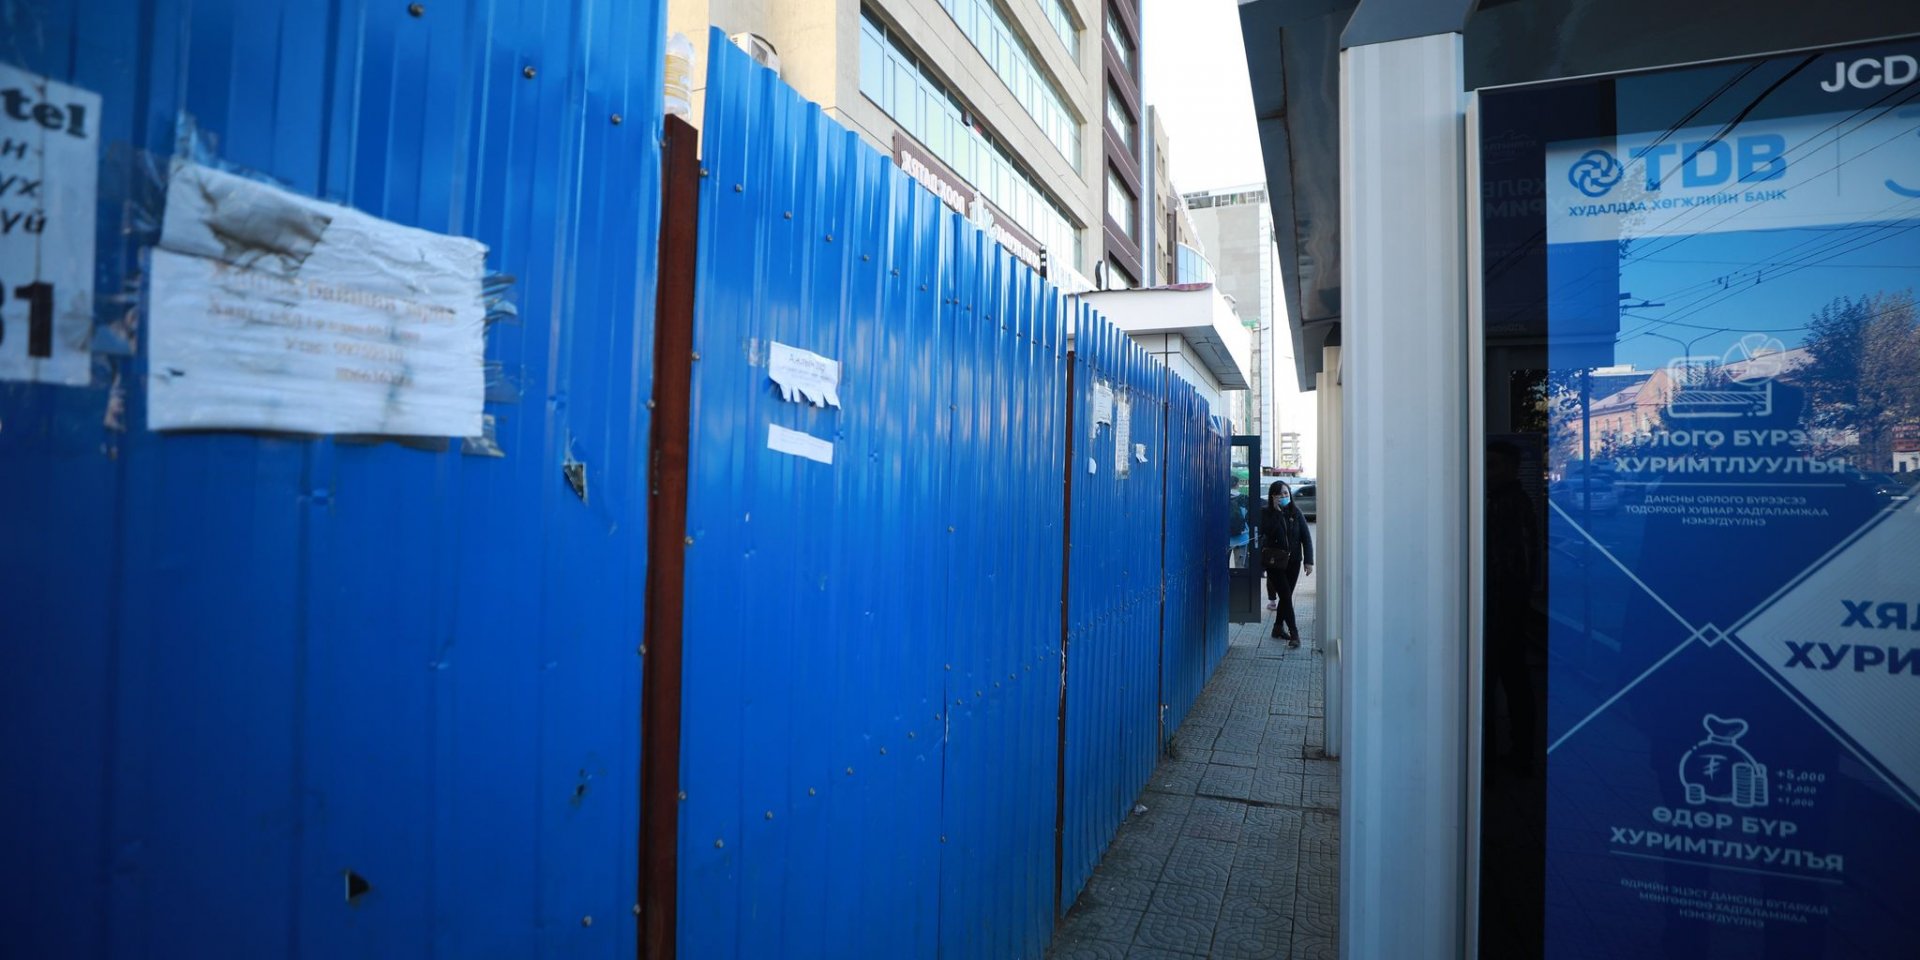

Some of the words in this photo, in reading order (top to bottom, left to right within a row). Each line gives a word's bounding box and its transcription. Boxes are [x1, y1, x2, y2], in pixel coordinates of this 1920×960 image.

[1820, 55, 1920, 92] JCD
[1629, 134, 1787, 191] TDB
[1568, 203, 1646, 217] ХУДАЛДАА
[1651, 194, 1738, 210] ХӨГЖЛИЙН
[1745, 189, 1787, 202] БАНК
[0, 281, 54, 357] 1
[1615, 457, 1846, 474] ХУРИМТЛУУЛЪЯ
[1626, 504, 1686, 515] ТОДОРХОЙ
[1688, 505, 1734, 515] ХУВИАР
[1736, 506, 1830, 517] ХАДГАЛАМЖАА
[1644, 495, 1695, 504] ДАНСНЫ
[1697, 495, 1744, 504] ОРЛОГО
[1746, 496, 1807, 505] БҮРЭЭСЭЭ
[1682, 517, 1766, 527] НЭМЭГДҮҮЛНЭ
[1784, 641, 1920, 675] ХУРИ
[1652, 806, 1733, 829] ӨДӨР
[1742, 816, 1798, 837] БҮР
[1610, 826, 1844, 872] ХУРИМТЛУУЛЪЯ
[1710, 892, 1763, 906] ДАНСНЫ
[1680, 909, 1765, 928] НЭМЭГДҮҮЛНЭ
[1715, 901, 1808, 923] ХАДГАЛАМЖАА
